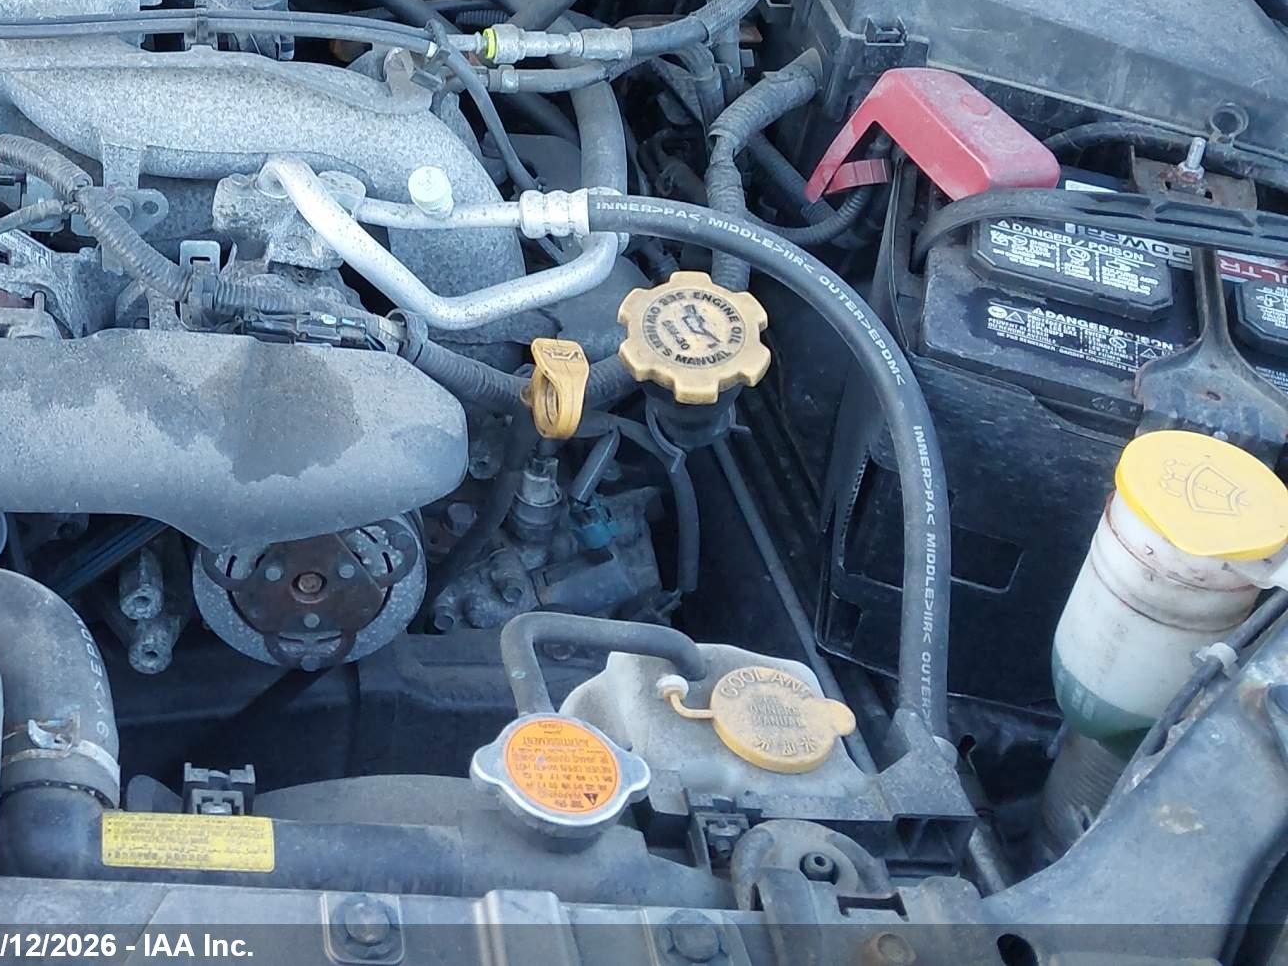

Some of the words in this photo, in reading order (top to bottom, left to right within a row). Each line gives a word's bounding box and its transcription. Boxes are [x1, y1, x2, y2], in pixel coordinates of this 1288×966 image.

[1012, 222, 1074, 244] DANGER
[1087, 241, 1145, 262] POISON
[693, 291, 738, 323] ENGINE
[728, 325, 743, 344] OIL
[675, 350, 732, 366] MANUAL
